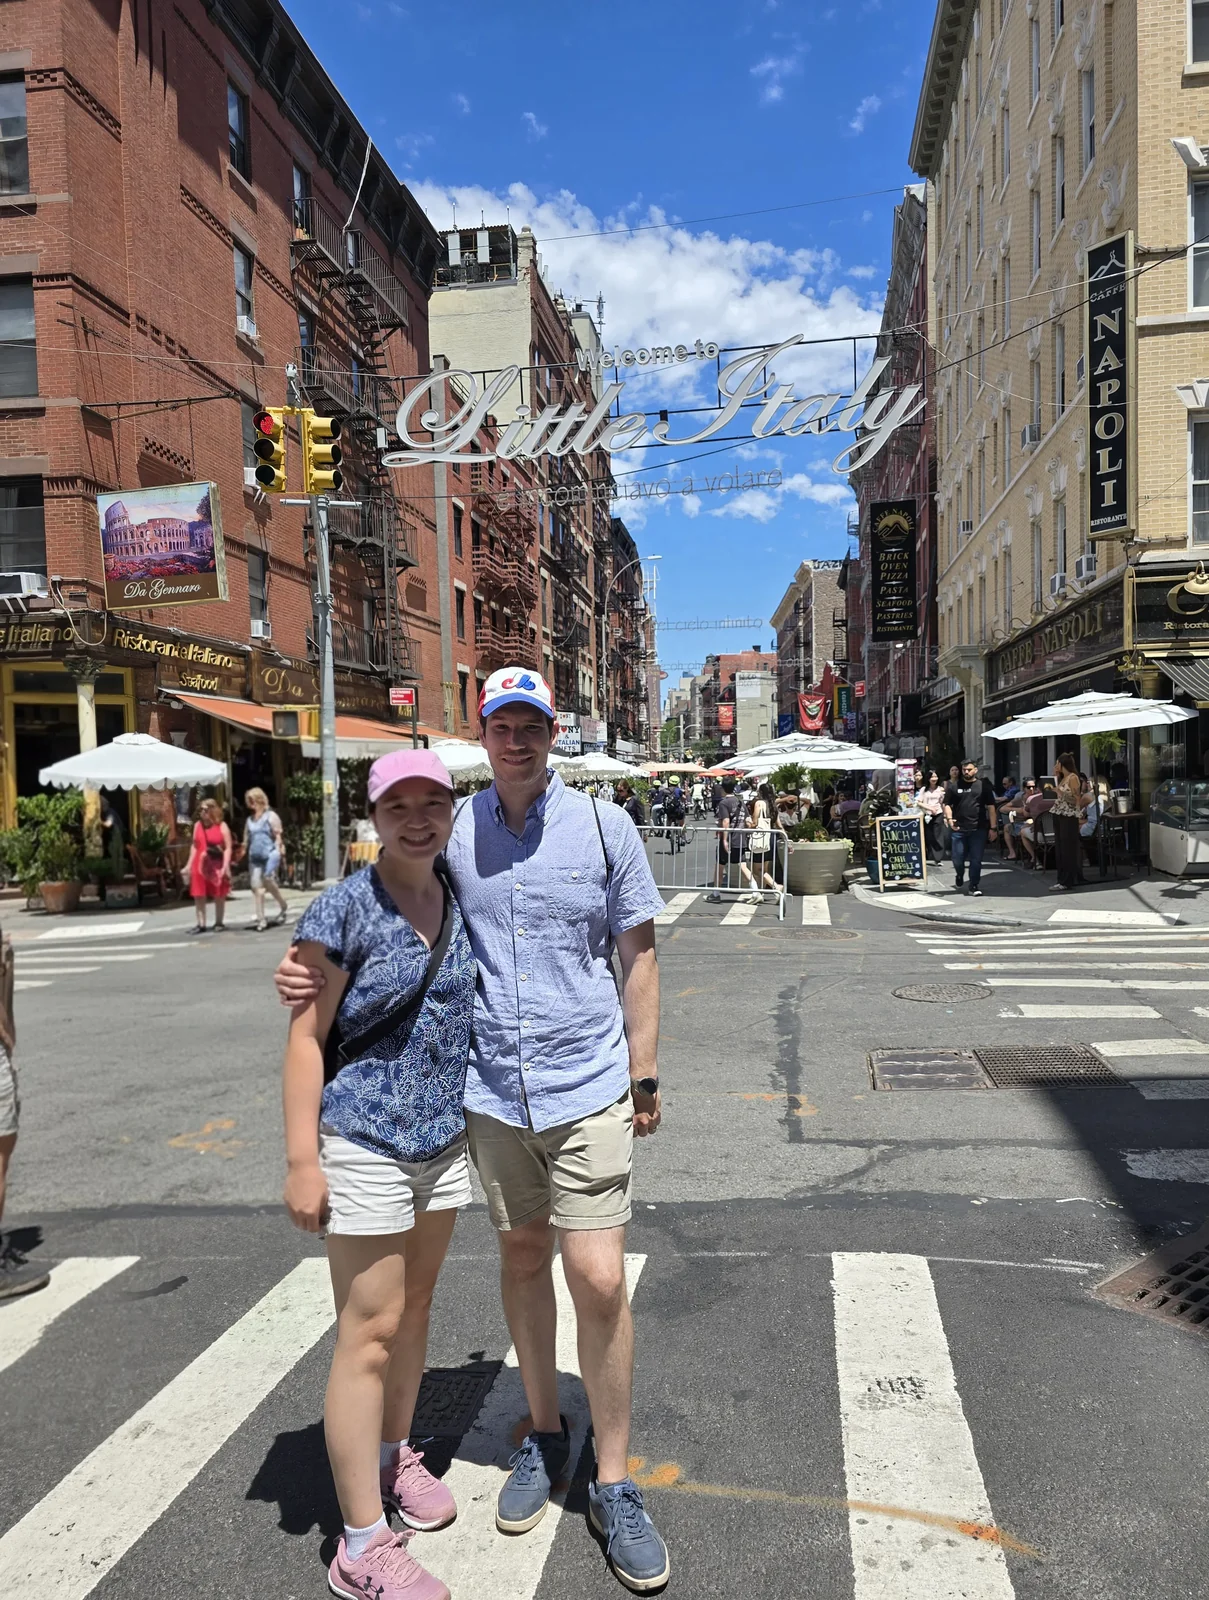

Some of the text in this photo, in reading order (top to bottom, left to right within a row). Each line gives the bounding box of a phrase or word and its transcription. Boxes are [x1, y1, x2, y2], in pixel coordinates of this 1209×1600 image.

[1089, 282, 1126, 302] CAFFE
[575, 338, 720, 371] Welcome to
[381, 333, 930, 474] Little Italy
[1093, 307, 1125, 508] NAPOLI
[704, 465, 783, 494] volare
[892, 508, 915, 531] NAPOLI
[1090, 512, 1127, 526] RISTORANTE
[879, 551, 909, 561] BRICK
[880, 562, 908, 571] OVEN
[880, 571, 908, 580] PIZZA
[123, 578, 201, 600] Da Gennaro
[880, 586, 909, 595] PASTA
[876, 600, 913, 608] SEAFOOD
[876, 612, 913, 620] PASTRIES
[8, 623, 75, 643] Italiano
[876, 624, 914, 633] RISTORANTE
[1040, 602, 1105, 656] NAPOLI
[113, 629, 233, 668] Ristorante Italiano
[179, 671, 218, 691] Seafood
[260, 667, 304, 699] Da
[882, 830, 910, 841] LUNCH
